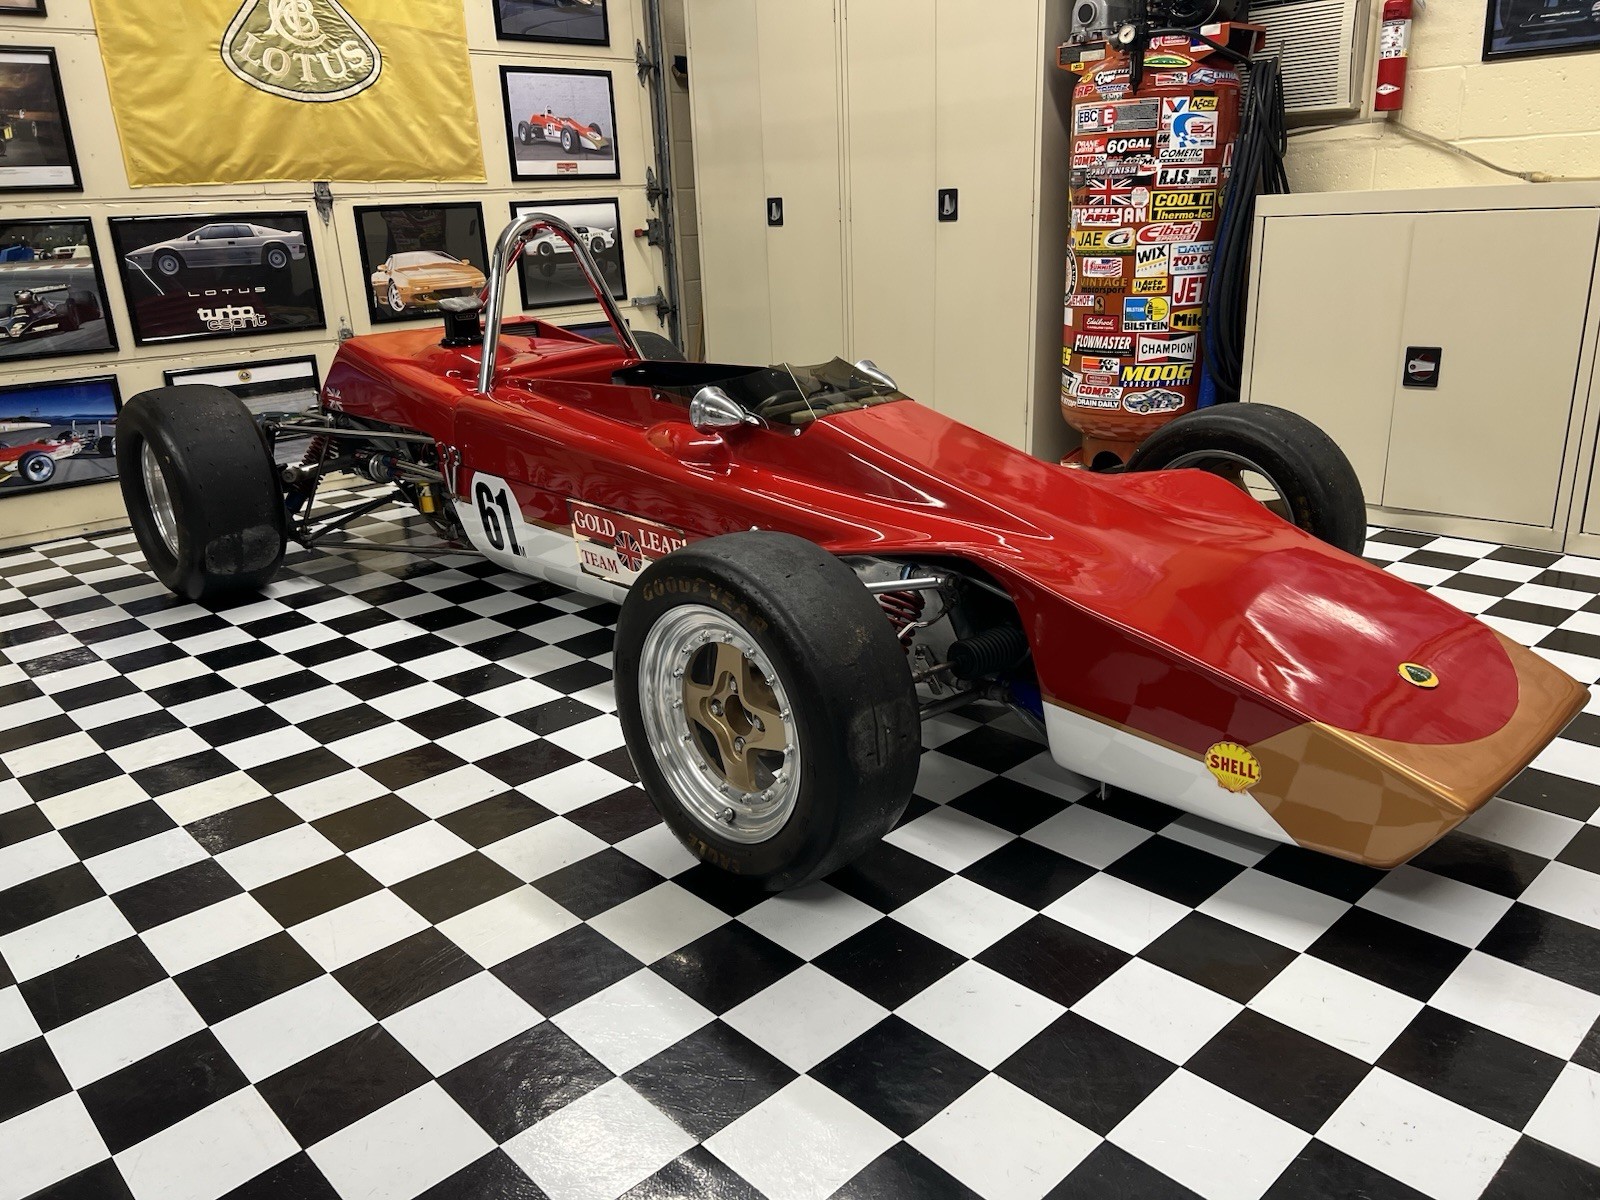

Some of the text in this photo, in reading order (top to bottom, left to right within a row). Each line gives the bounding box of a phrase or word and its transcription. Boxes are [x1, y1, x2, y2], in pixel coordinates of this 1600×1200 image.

[235, 31, 368, 83] LOTUS
[1079, 110, 1098, 123] EBC
[1106, 139, 1128, 154] 60
[1128, 138, 1152, 149] GAL
[1160, 148, 1203, 158] COMETIC
[1106, 165, 1137, 175] FINISH
[1154, 193, 1196, 206] COOL
[1198, 192, 1213, 205] IT
[1084, 214, 1120, 222] ARP
[1078, 232, 1103, 246] JAE
[1137, 245, 1167, 264] WIX
[1173, 255, 1198, 267] TOP
[1080, 277, 1128, 287] VINTAGE
[187, 286, 267, 298] LOTUS
[1081, 286, 1126, 295] motorsport
[197, 304, 255, 321] turbo
[207, 313, 268, 331] esprit
[1124, 321, 1168, 331] BILSTEIN
[1074, 334, 1132, 352] FLOWMASTER
[1141, 342, 1193, 354] CHAMPION
[1120, 364, 1194, 382] MOOG
[1079, 385, 1111, 395] COMP
[1077, 397, 1098, 407] DRAIN
[1098, 399, 1119, 408] DAILY
[475, 481, 521, 557] 61
[573, 510, 616, 538] GOLD
[581, 549, 620, 575] TEAM
[1210, 754, 1256, 780] SHELL
